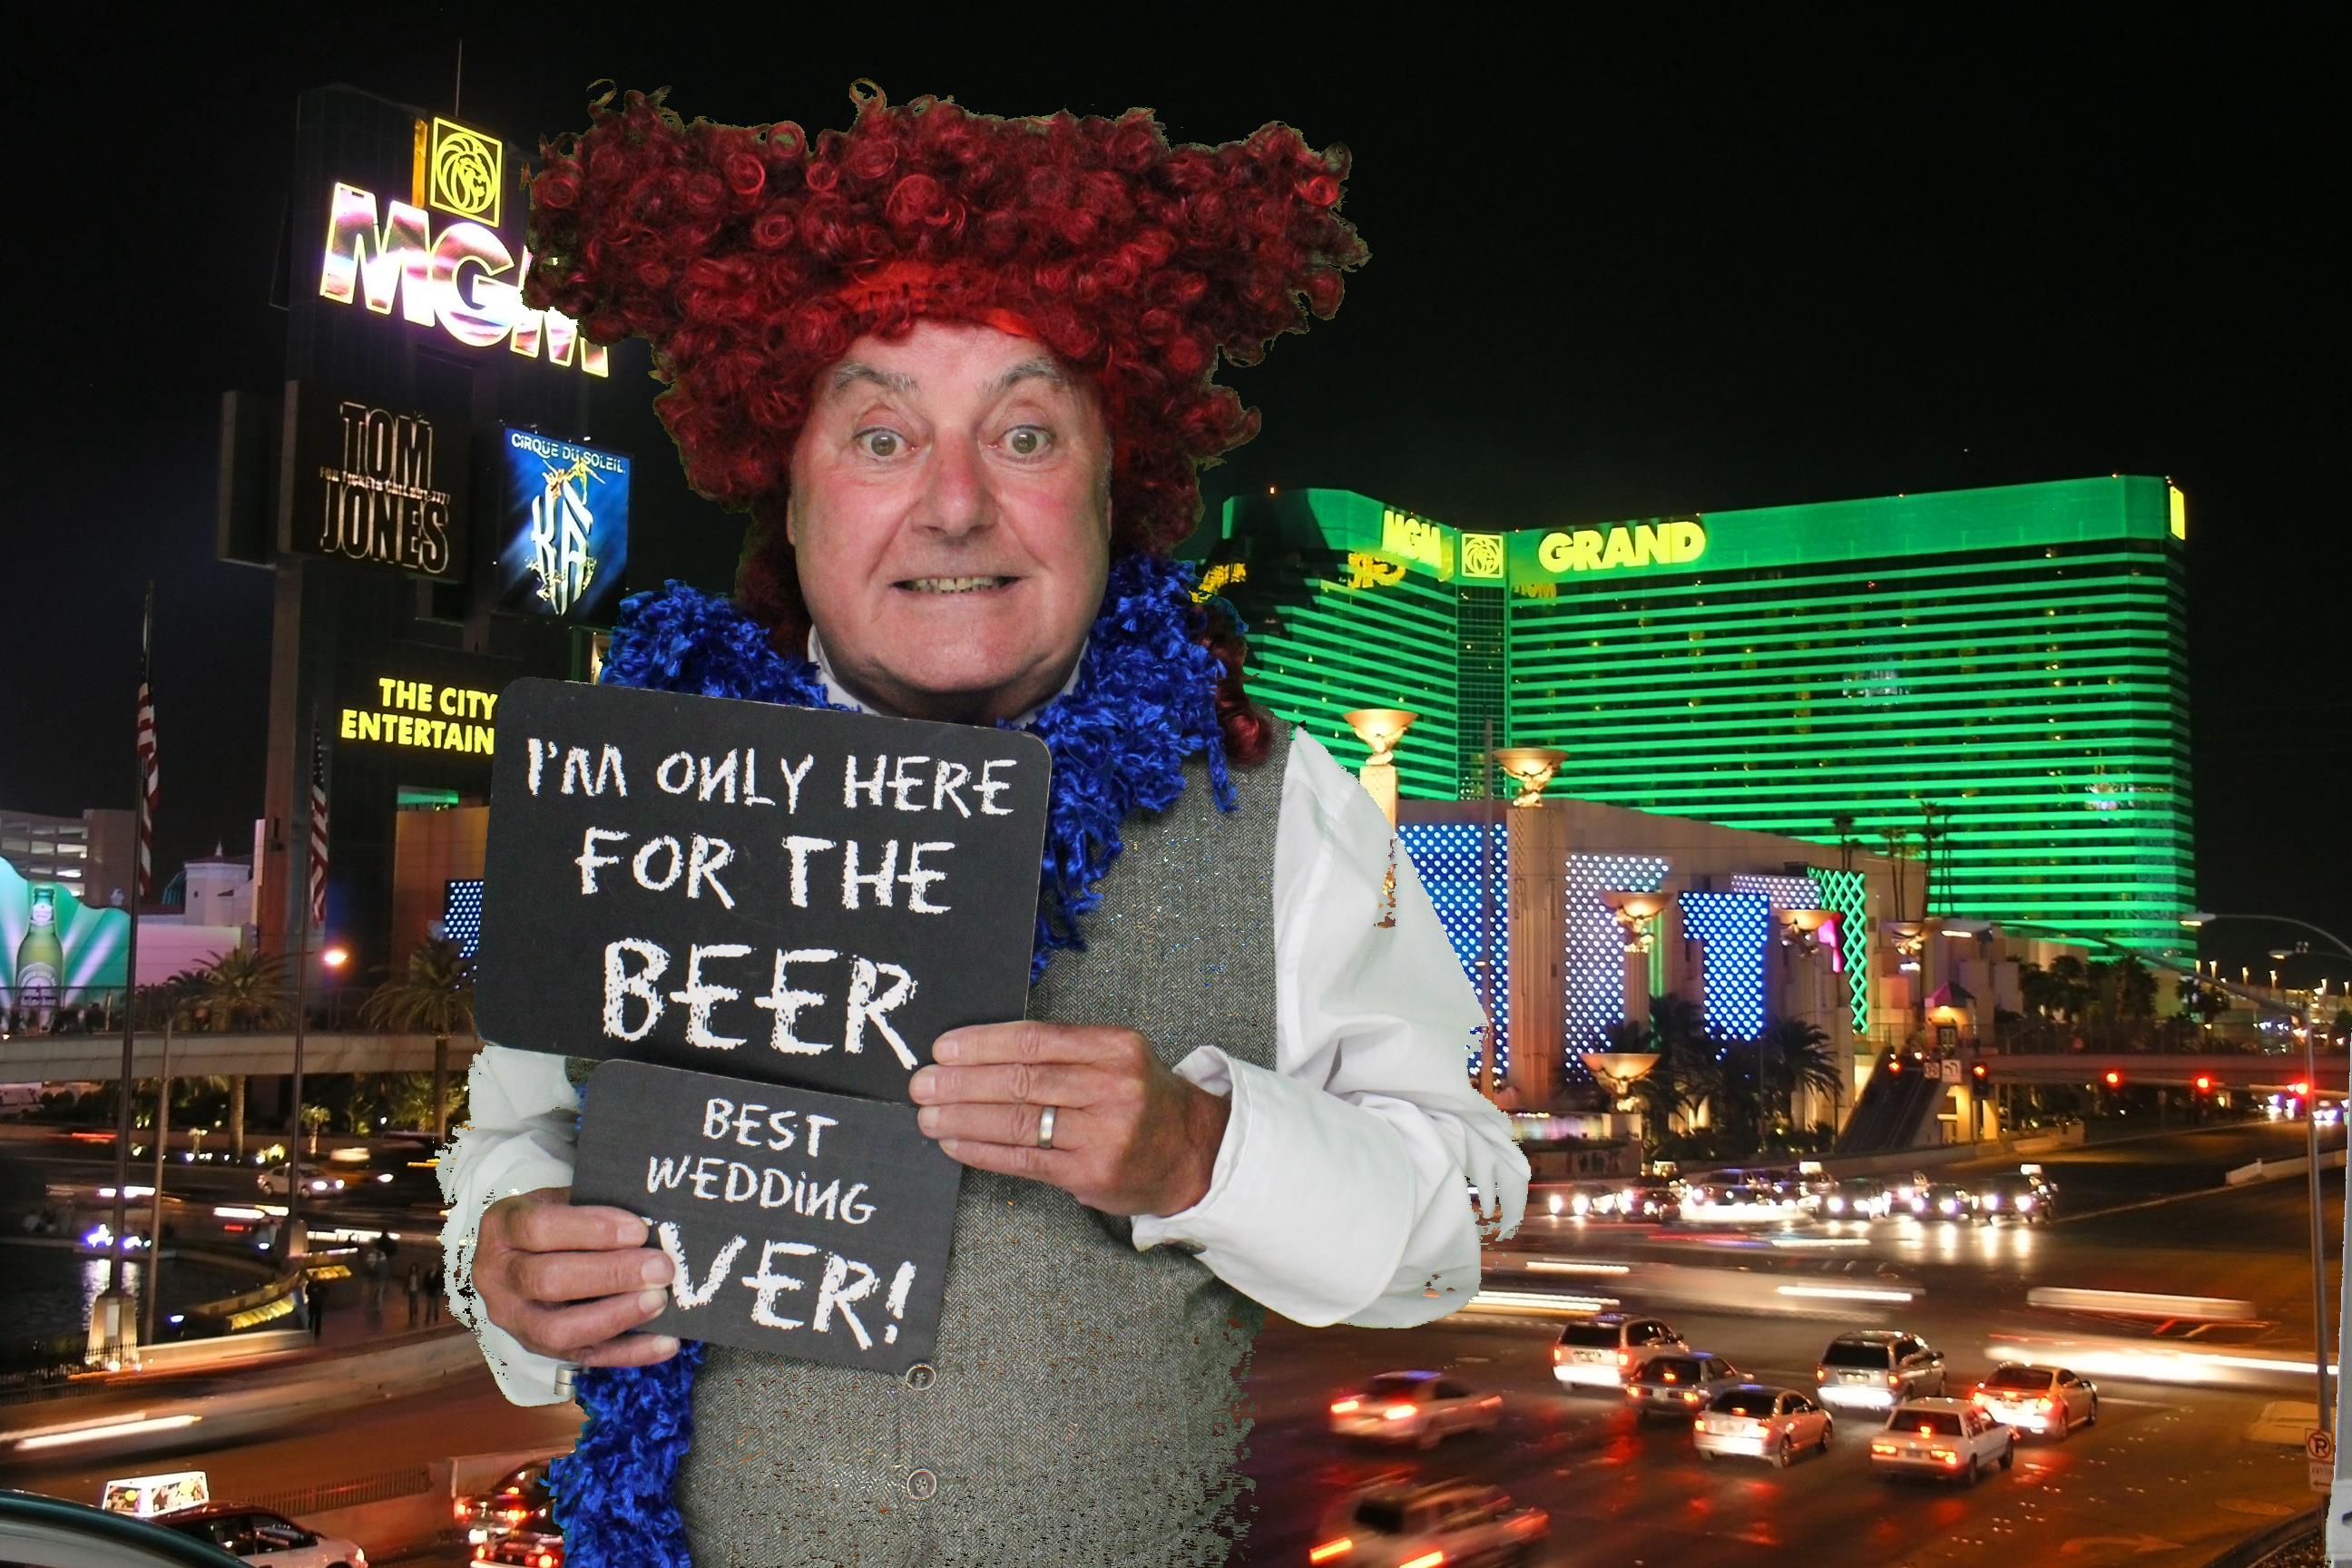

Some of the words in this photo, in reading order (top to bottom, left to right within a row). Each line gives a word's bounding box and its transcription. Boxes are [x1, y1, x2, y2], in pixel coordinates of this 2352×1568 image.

[339, 401, 433, 490] TOM
[563, 446, 580, 462] DU
[319, 481, 450, 574] JONES
[1381, 510, 1443, 569] MGM
[1538, 521, 1707, 573] GRAND
[340, 709, 495, 755] ENTERTAIN
[378, 677, 433, 712] THE
[439, 687, 498, 720] CITY
[527, 738, 628, 798] I'M
[656, 747, 814, 815] ONLY
[843, 754, 1017, 819] HERE
[574, 826, 736, 910] FOR
[781, 835, 956, 915] THE
[603, 937, 918, 1071] BEER
[699, 1097, 839, 1158] BEST
[642, 1216, 917, 1351] VER!
